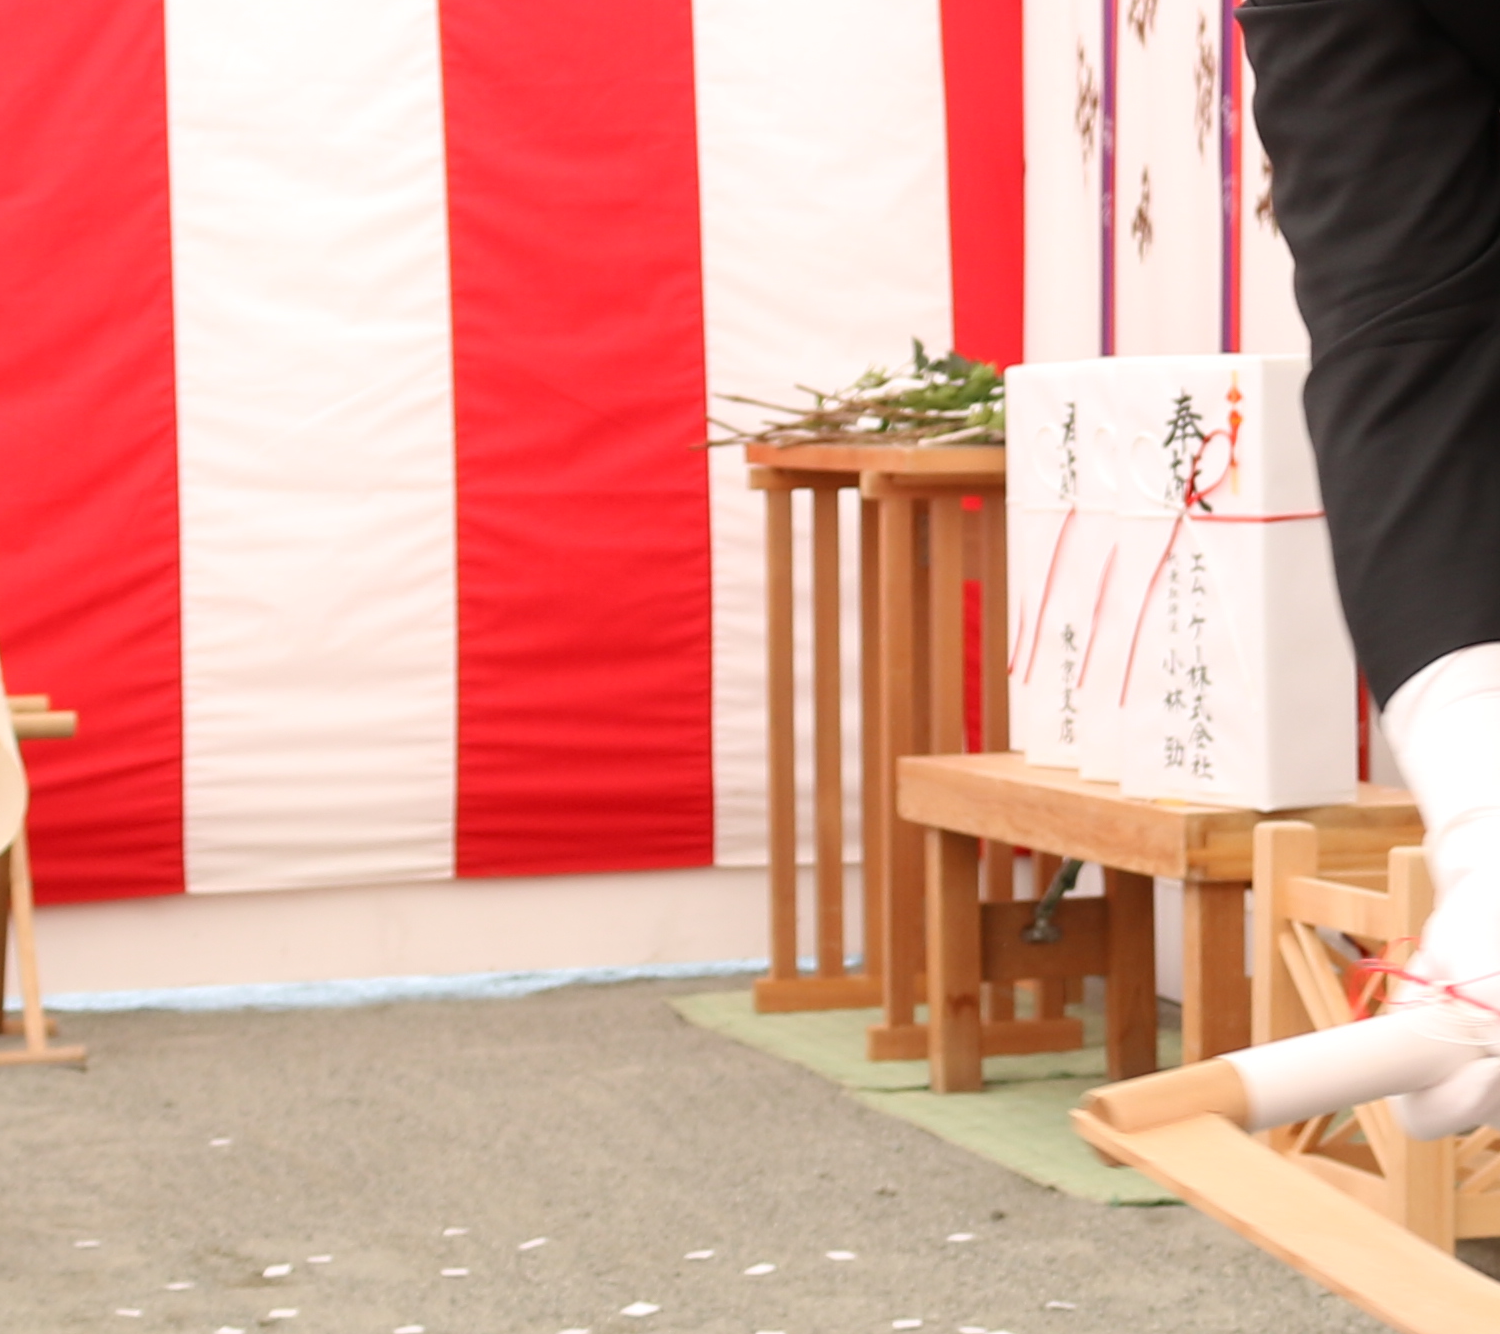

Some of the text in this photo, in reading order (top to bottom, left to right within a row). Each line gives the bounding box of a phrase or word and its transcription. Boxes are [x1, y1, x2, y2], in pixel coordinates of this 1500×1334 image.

[1187, 552, 1214, 781] エム・ケー株式会社
